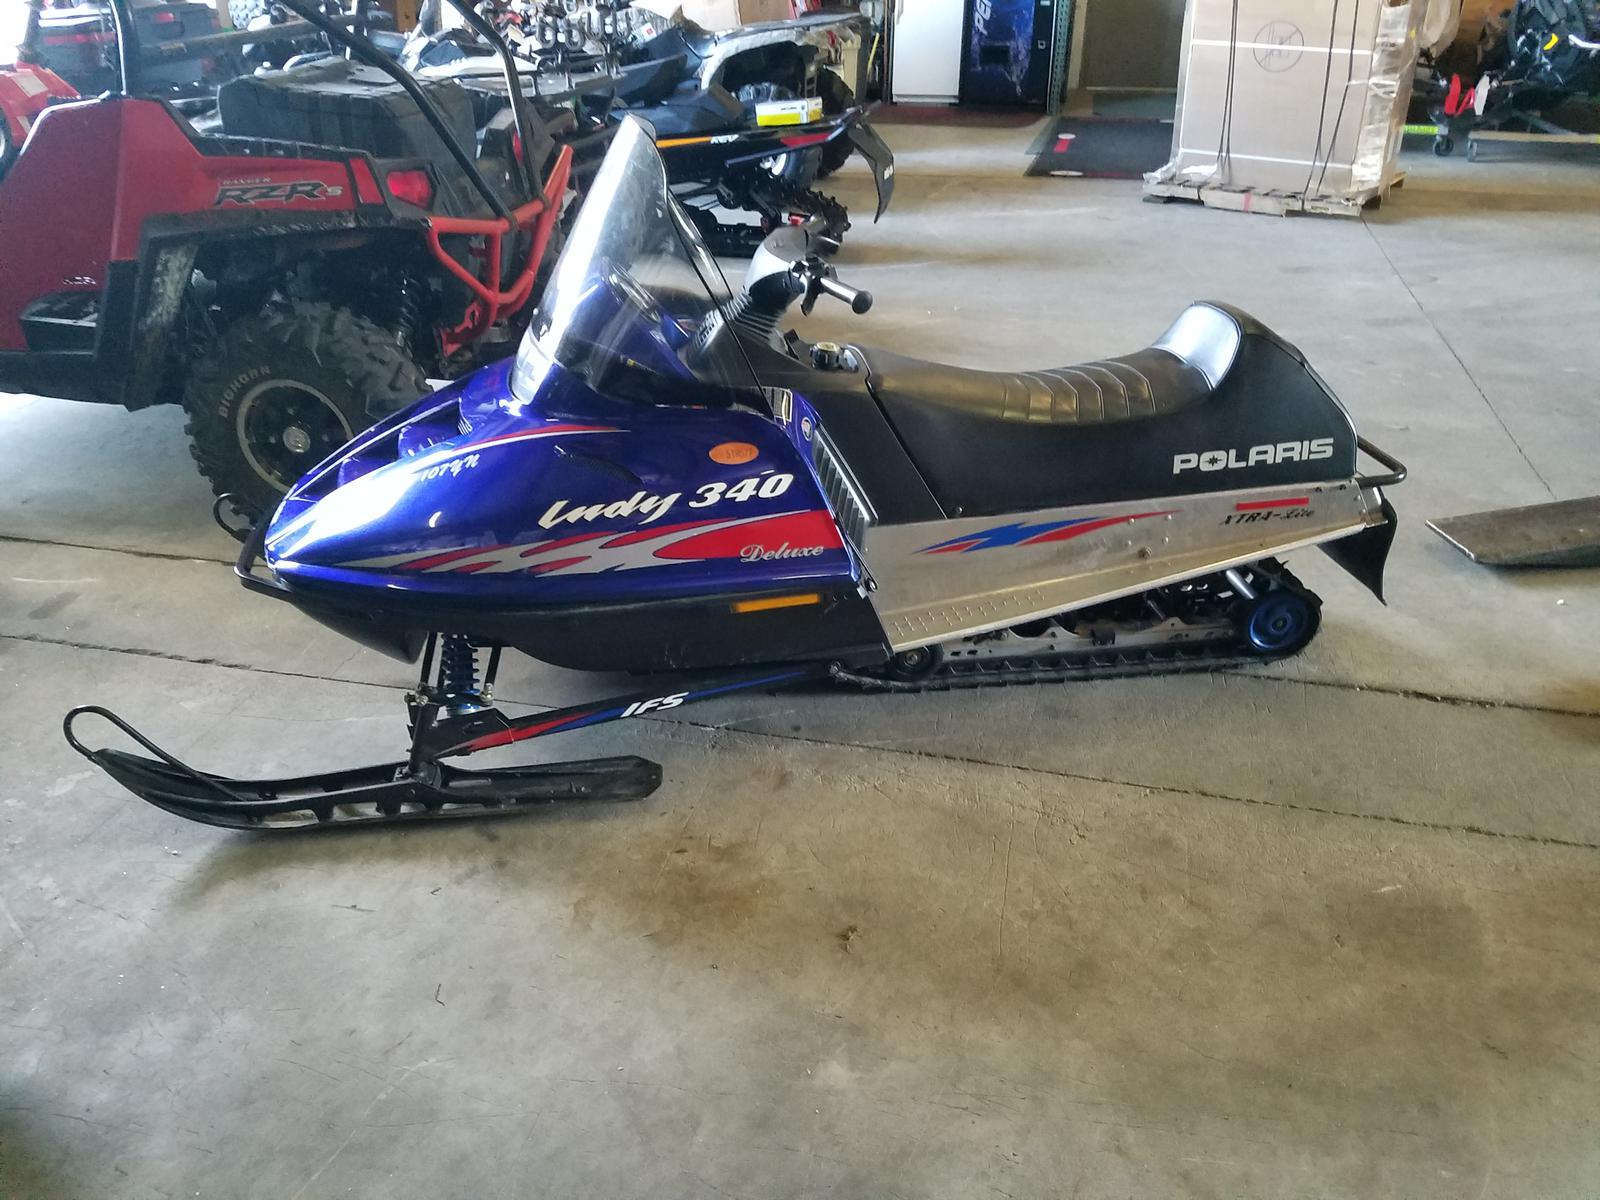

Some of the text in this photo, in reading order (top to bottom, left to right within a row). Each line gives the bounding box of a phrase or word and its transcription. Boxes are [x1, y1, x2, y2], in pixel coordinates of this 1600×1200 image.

[973, 0, 993, 36] PE
[1172, 437, 1334, 475] POLARIS
[537, 473, 794, 529] Indy 340
[739, 541, 825, 563] Deluxe
[620, 691, 690, 718] IFS
